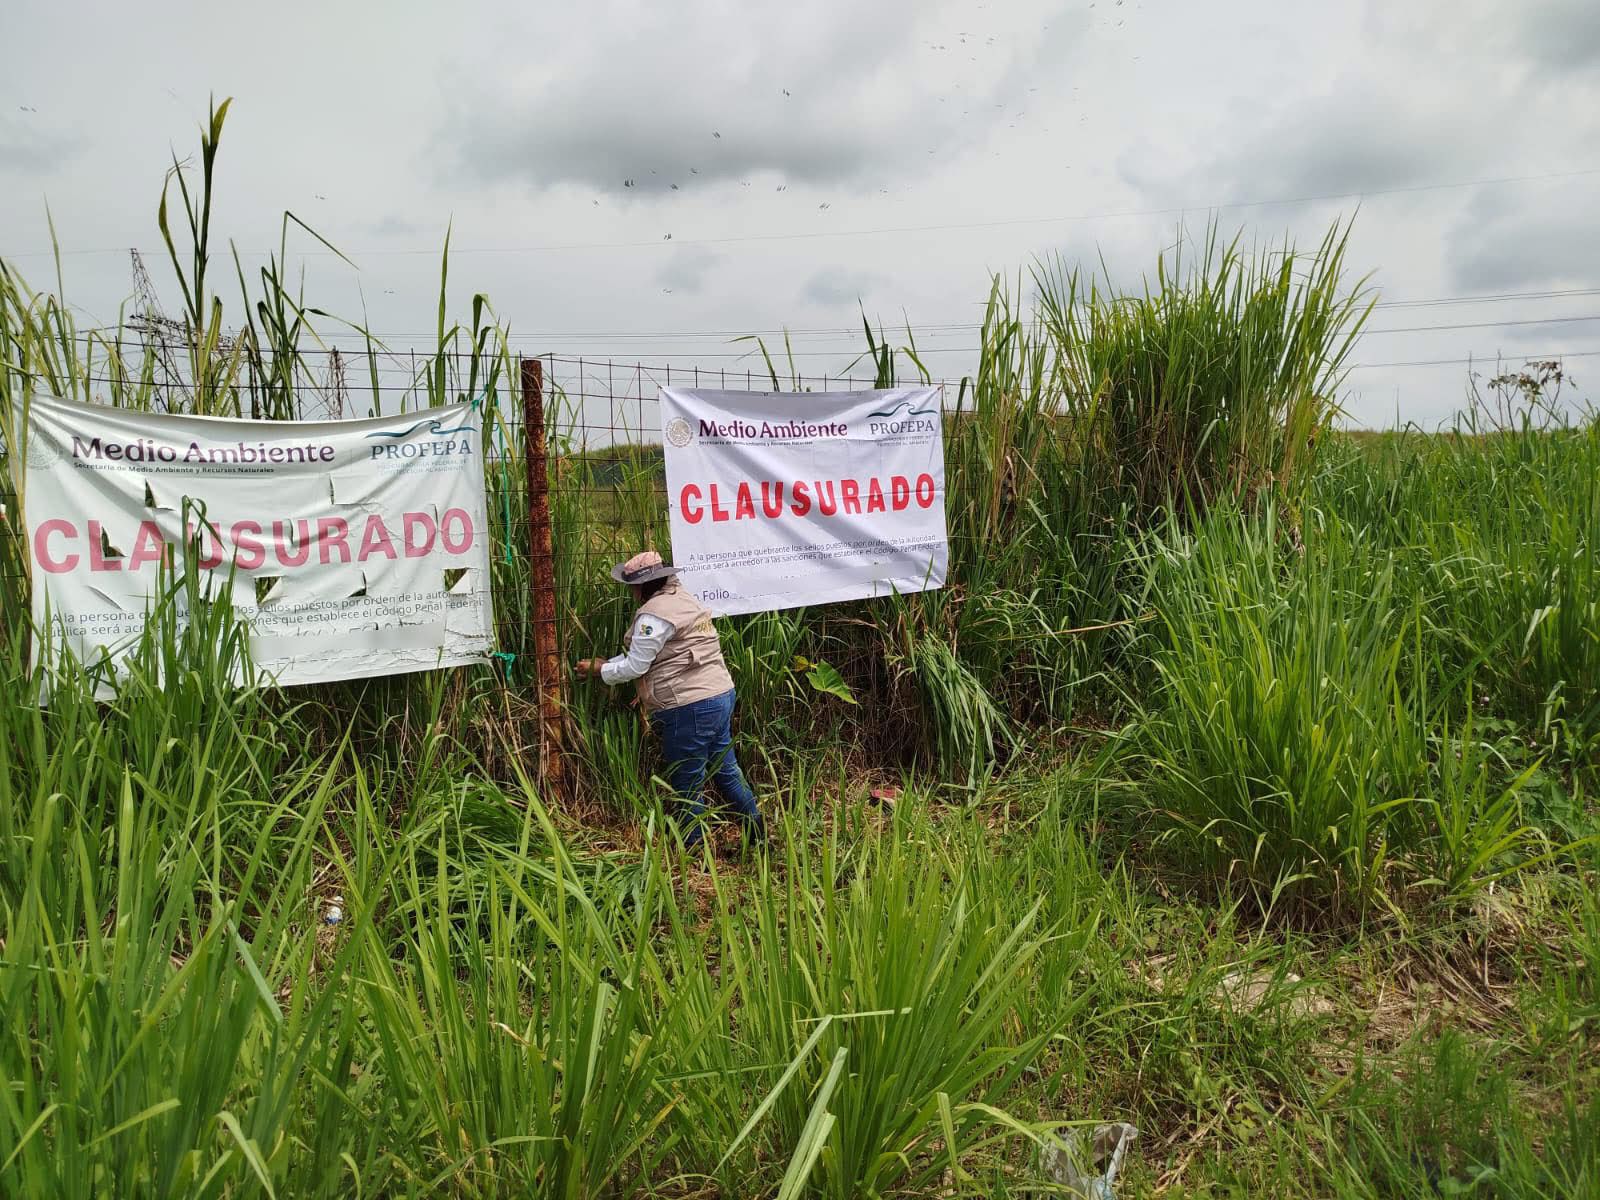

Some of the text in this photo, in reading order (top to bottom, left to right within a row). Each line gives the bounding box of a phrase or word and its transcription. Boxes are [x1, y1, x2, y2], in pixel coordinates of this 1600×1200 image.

[699, 419, 848, 438] Medio Ambiente
[870, 420, 934, 434] PROFEPA
[72, 436, 335, 463] Medio Ambiente
[371, 439, 472, 460] PROFEPA
[128, 465, 154, 473] Medio
[155, 466, 194, 474] Ambiente
[680, 473, 935, 524] CLAUSURADO
[689, 553, 695, 561] A
[697, 552, 704, 561] la
[706, 551, 737, 562] persona
[738, 549, 753, 559] que
[792, 544, 802, 552] los
[804, 543, 824, 552] sellos
[853, 540, 866, 549] por
[683, 562, 712, 574] pública
[713, 560, 729, 569] será
[730, 558, 763, 568] acreedor
[818, 552, 832, 561] que
[294, 600, 339, 613] puestos
[341, 598, 361, 610] por
[363, 594, 396, 606] orden
[398, 593, 411, 603] de
[415, 591, 423, 601] la
[702, 588, 730, 601] Folio
[64, 612, 75, 623] la
[80, 611, 135, 624] persona
[281, 615, 304, 627] que
[306, 610, 360, 622] establece
[362, 608, 372, 617] el
[91, 623, 120, 635] será
